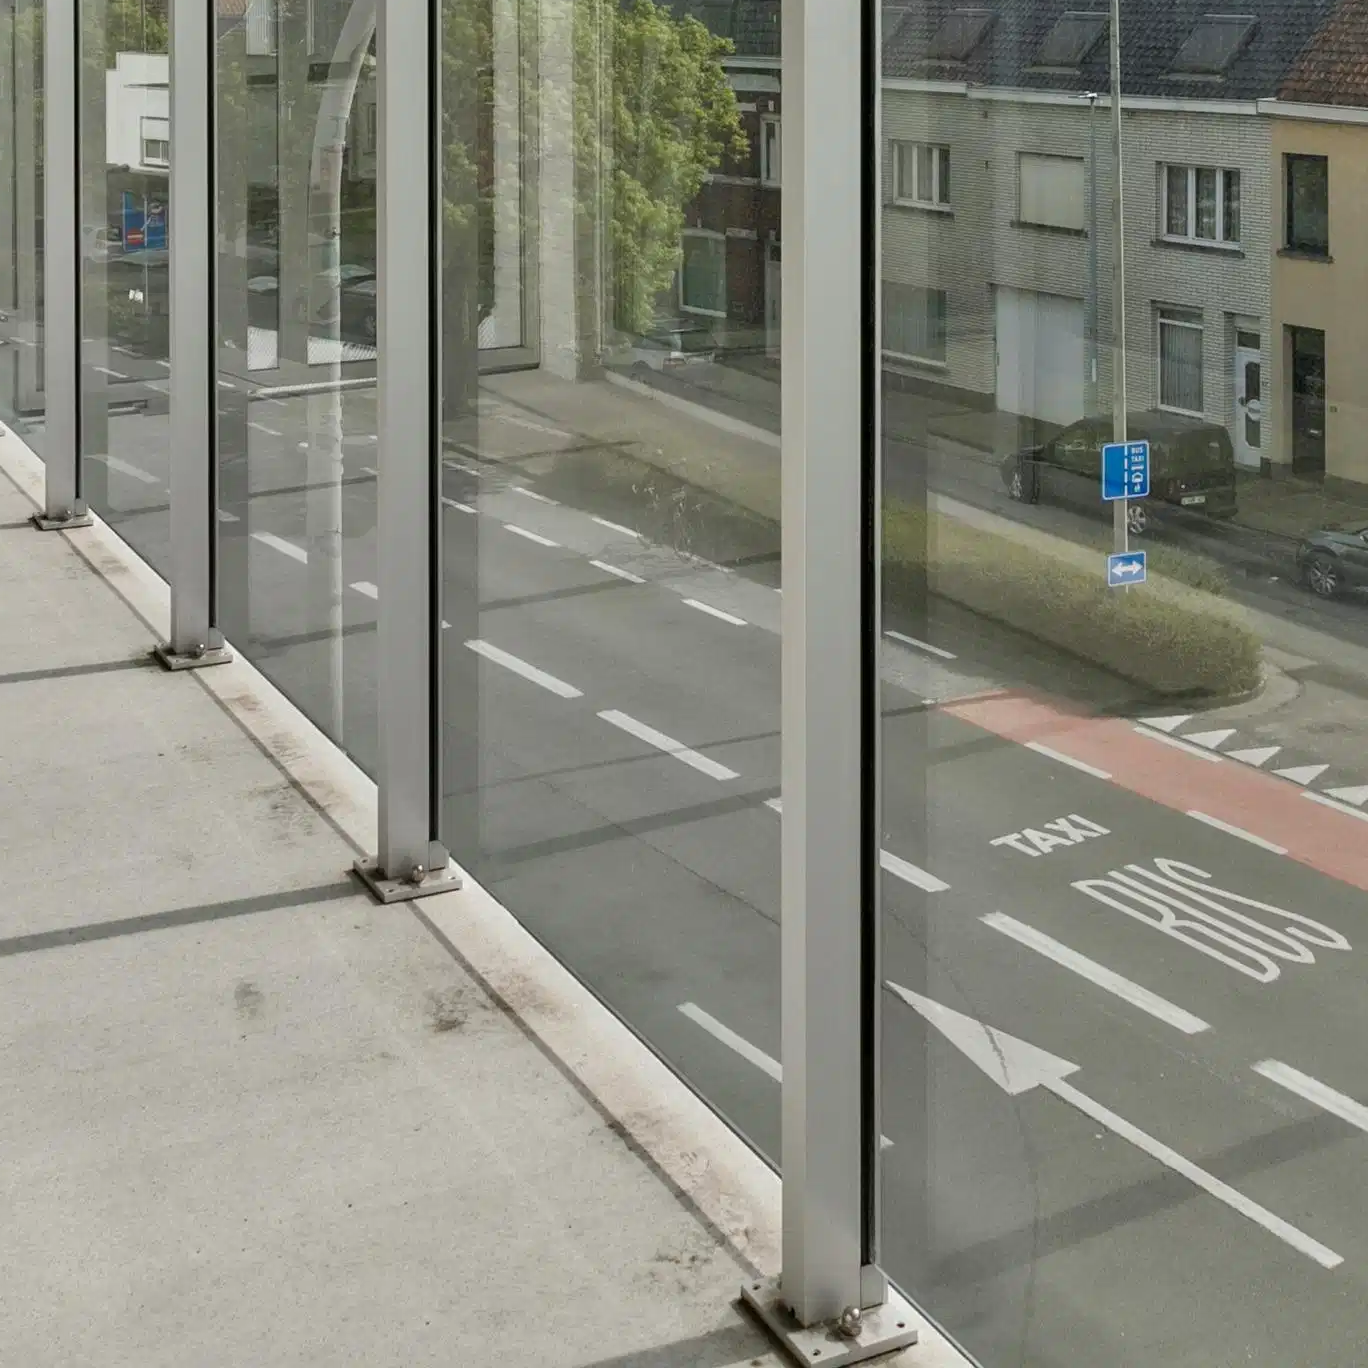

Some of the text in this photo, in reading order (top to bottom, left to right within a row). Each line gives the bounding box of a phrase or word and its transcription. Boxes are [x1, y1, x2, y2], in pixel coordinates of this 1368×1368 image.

[1131, 446, 1143, 454] BUS
[1131, 455, 1144, 463] TAXI
[989, 814, 1111, 857] TAXI
[1070, 858, 1352, 983] BUS
